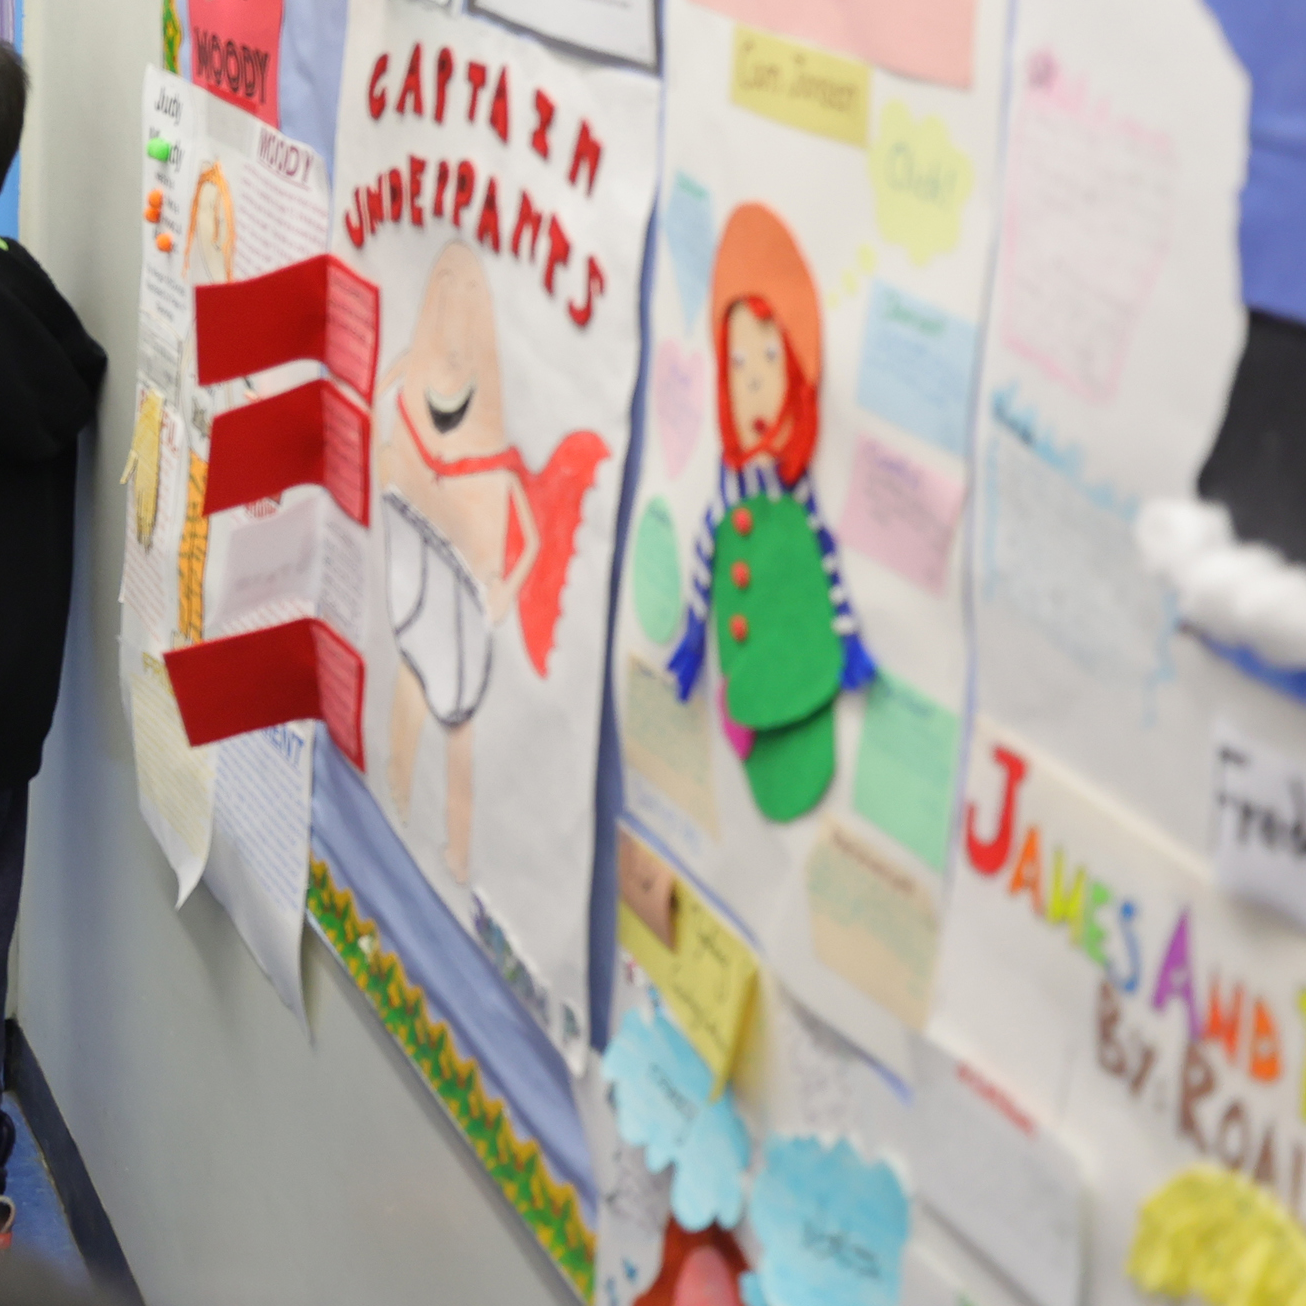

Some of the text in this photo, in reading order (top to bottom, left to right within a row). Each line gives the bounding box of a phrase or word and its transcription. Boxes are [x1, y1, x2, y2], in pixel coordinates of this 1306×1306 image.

[368, 42, 603, 198] CAPTAIN
[343, 152, 607, 330] UNDERPANTS
[965, 744, 1141, 994] JAMES
[1152, 907, 1281, 1083] AND
